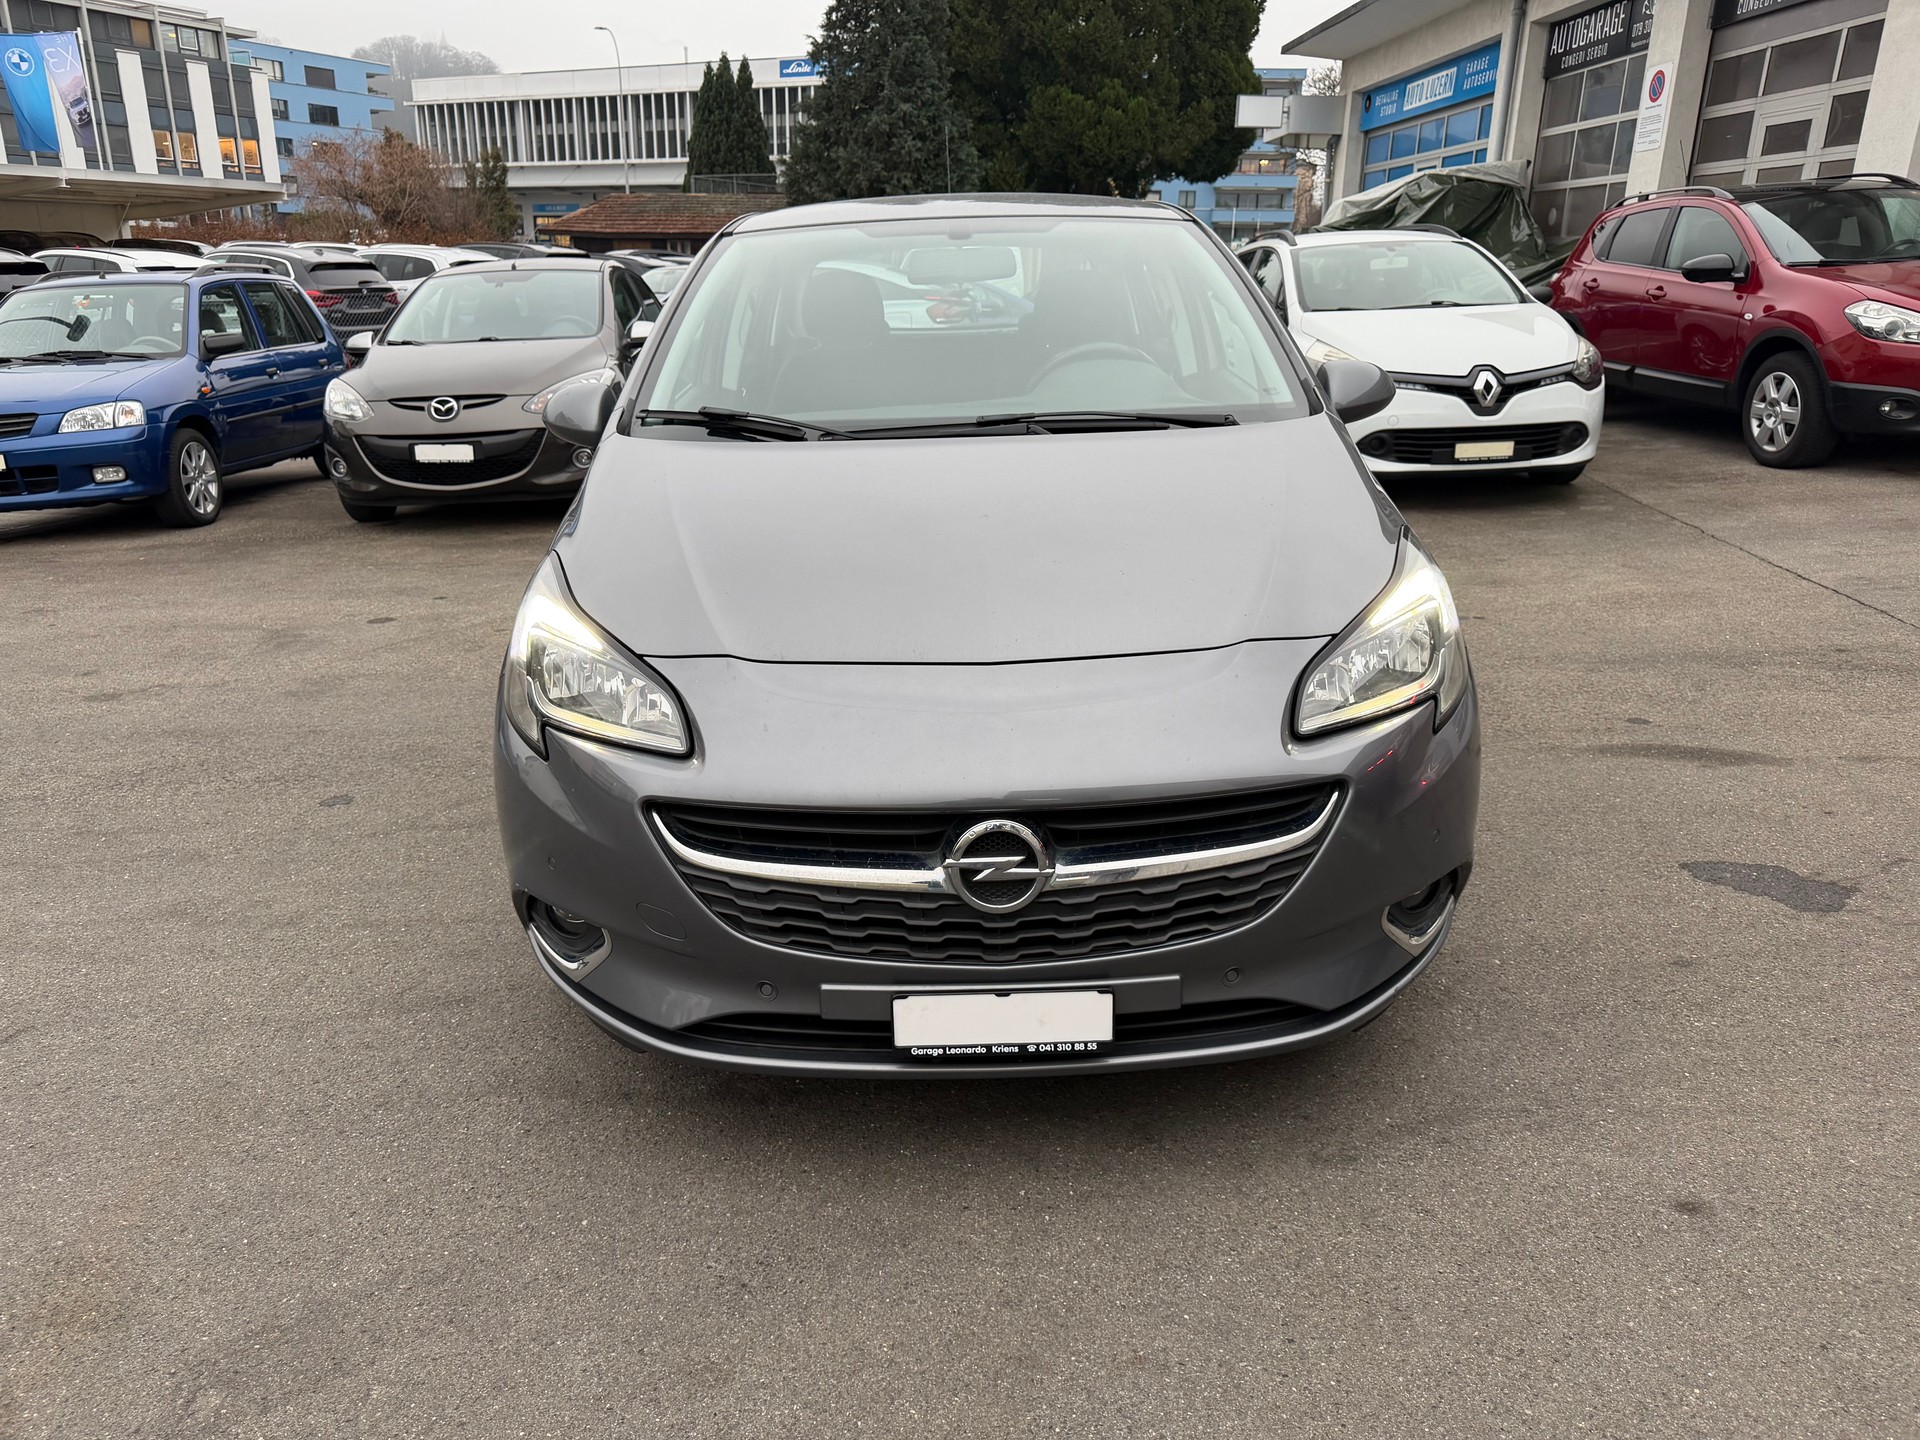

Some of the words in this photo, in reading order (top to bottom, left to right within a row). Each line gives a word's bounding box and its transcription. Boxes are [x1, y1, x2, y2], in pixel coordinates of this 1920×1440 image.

[1550, 0, 1627, 56] AUTOGARAGE
[1632, 22, 1643, 37] 079
[1561, 50, 1586, 69] CONGEDI
[1586, 42, 1608, 60] SERGIO
[783, 61, 812, 73] Linde
[1466, 56, 1490, 75] GARAGE
[1405, 82, 1425, 108] AUTO
[1424, 71, 1456, 101] LUZERN
[1380, 103, 1397, 117] STUDIO
[911, 1047, 943, 1056] Garage
[946, 1046, 987, 1054] Leonardo
[992, 1045, 1019, 1053] Kriens
[1039, 1044, 1054, 1052] 041
[1057, 1043, 1072, 1051] 310
[1074, 1043, 1085, 1051] 88
[1087, 1042, 1098, 1050] 55
